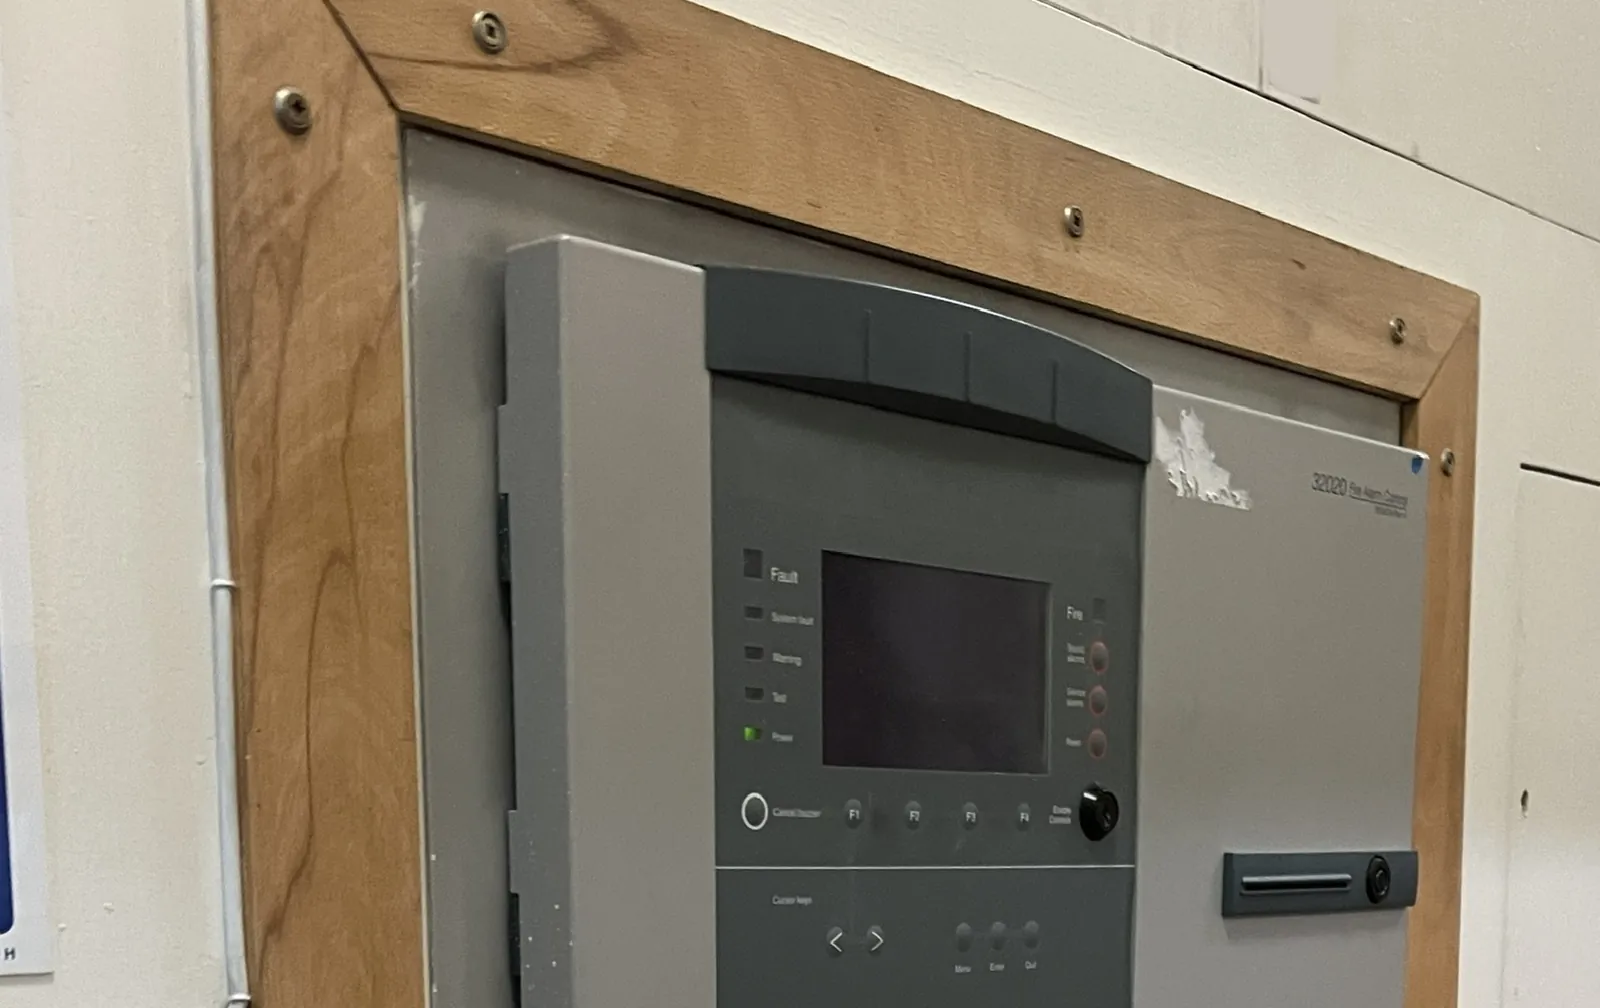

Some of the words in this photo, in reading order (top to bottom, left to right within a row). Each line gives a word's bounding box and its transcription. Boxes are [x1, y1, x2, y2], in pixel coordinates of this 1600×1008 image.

[1311, 472, 1348, 496] 32020
[770, 566, 799, 584] Fault
[1067, 606, 1084, 621] Fire
[849, 808, 860, 820] F1
[909, 810, 920, 822] F2
[966, 811, 976, 823] F3
